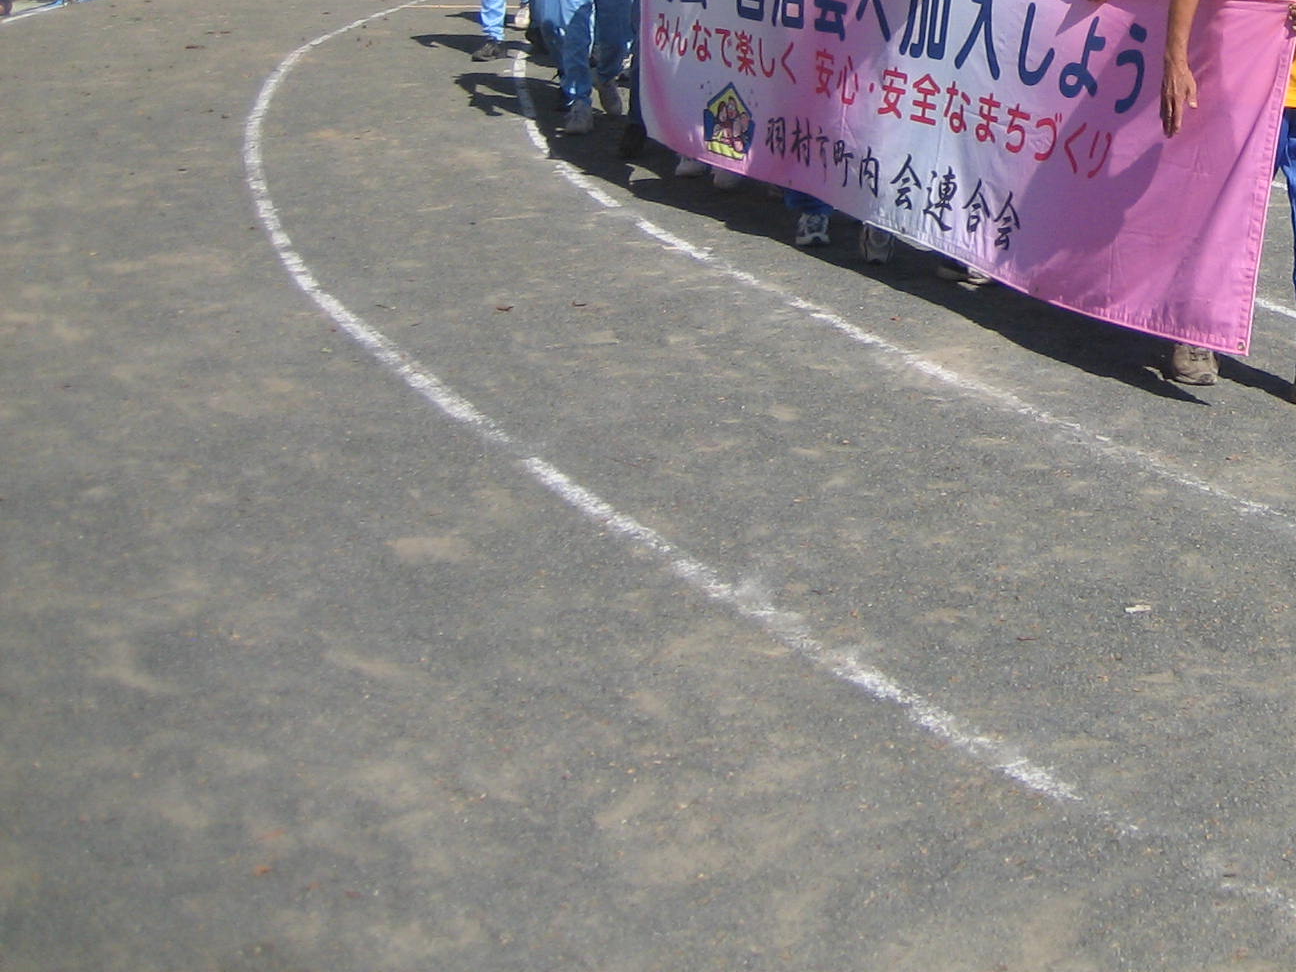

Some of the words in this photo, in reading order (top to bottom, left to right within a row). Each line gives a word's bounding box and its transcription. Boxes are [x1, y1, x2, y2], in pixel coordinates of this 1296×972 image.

[653, 12, 798, 85] みんなで楽しく
[815, 48, 1114, 180] 安心・安全なまちづくり
[765, 118, 1023, 253] 羽村市町内会連合会
